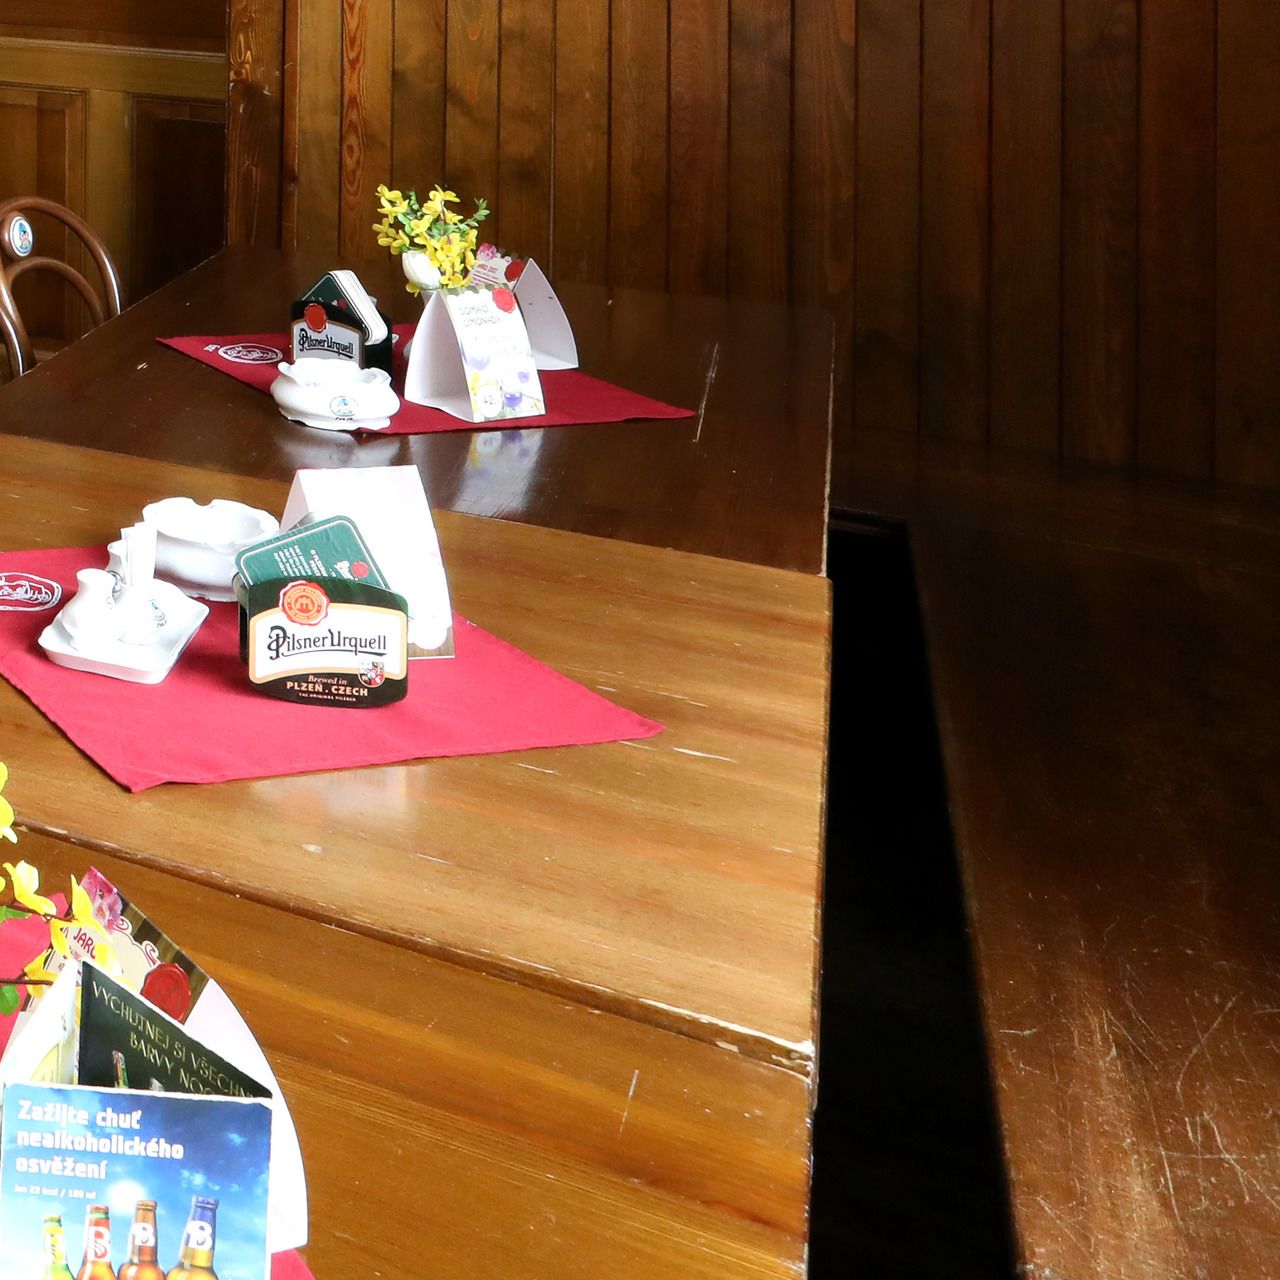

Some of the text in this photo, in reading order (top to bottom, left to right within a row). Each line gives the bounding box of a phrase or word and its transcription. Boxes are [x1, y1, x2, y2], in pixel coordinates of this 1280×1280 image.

[298, 328, 354, 358] Pilsner Urquell
[267, 625, 387, 660] Pilsner Urquell
[286, 681, 368, 697] PLZEŇ CZECH
[308, 675, 347, 685] Brewed in
[92, 980, 171, 1050] VYCHUTNEJ
[173, 1042, 186, 1062] SI
[130, 1031, 174, 1075] BARVY
[17, 1100, 143, 1130] Zažijte chuť
[16, 1130, 185, 1160] nealkoholického
[15, 1155, 108, 1181] osvěžení
